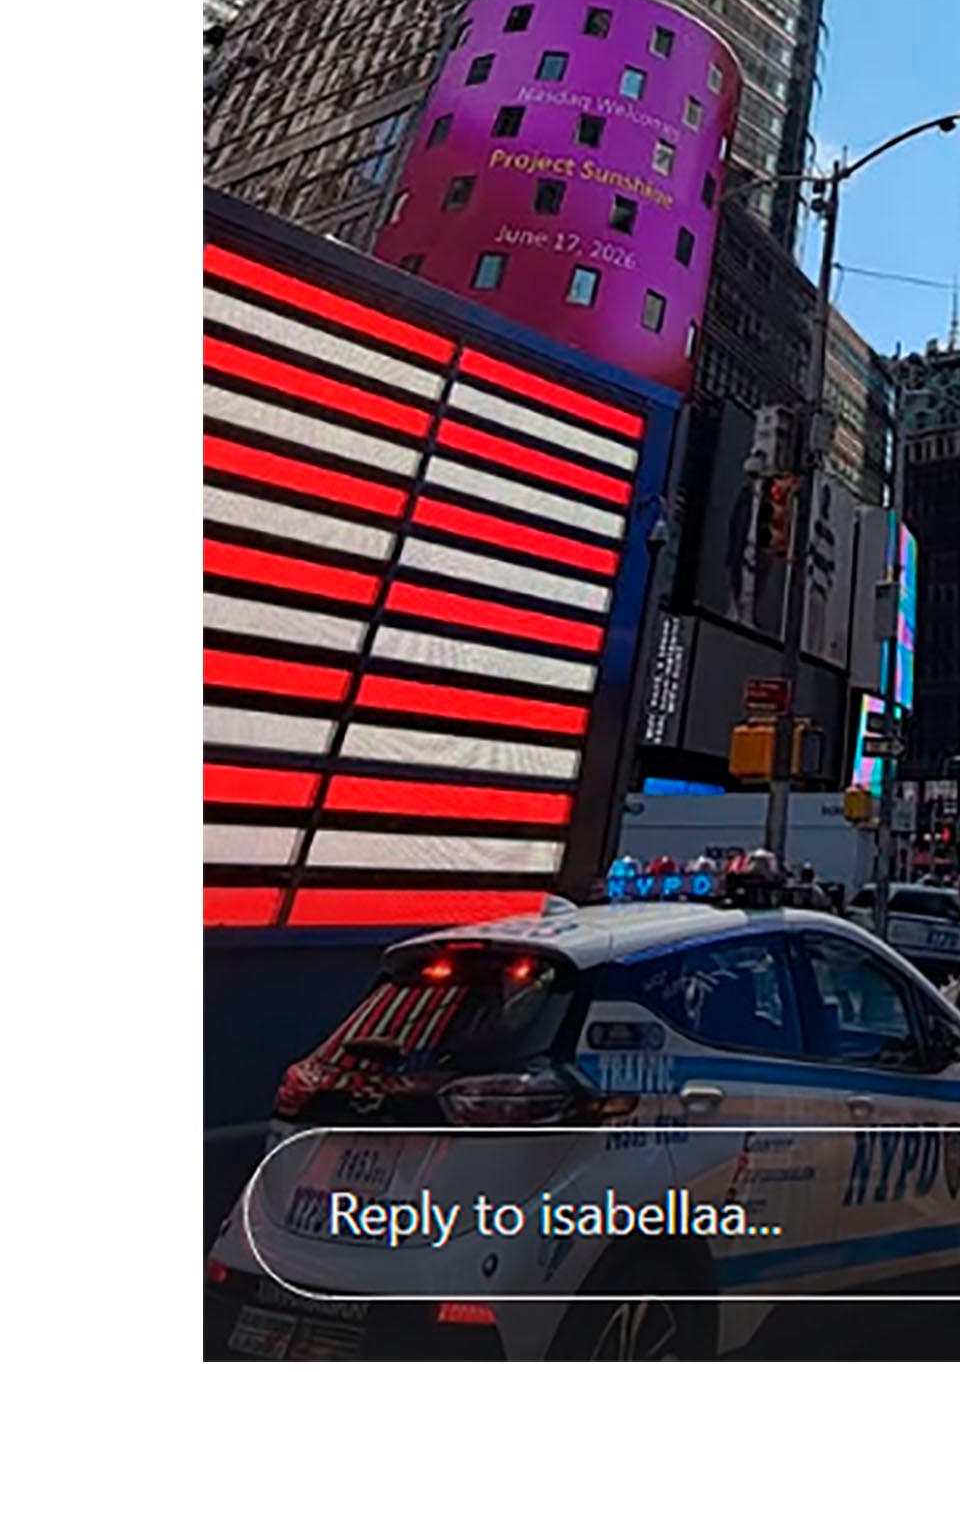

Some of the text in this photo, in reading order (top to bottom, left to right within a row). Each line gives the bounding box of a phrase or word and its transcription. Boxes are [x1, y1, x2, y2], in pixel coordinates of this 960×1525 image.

[516, 84, 592, 113] Nasdaq
[489, 149, 674, 212] Project Sunshine
[495, 225, 638, 272] June 17, 2026
[608, 872, 714, 899] NYPD
[842, 1122, 941, 1207] NYPD
